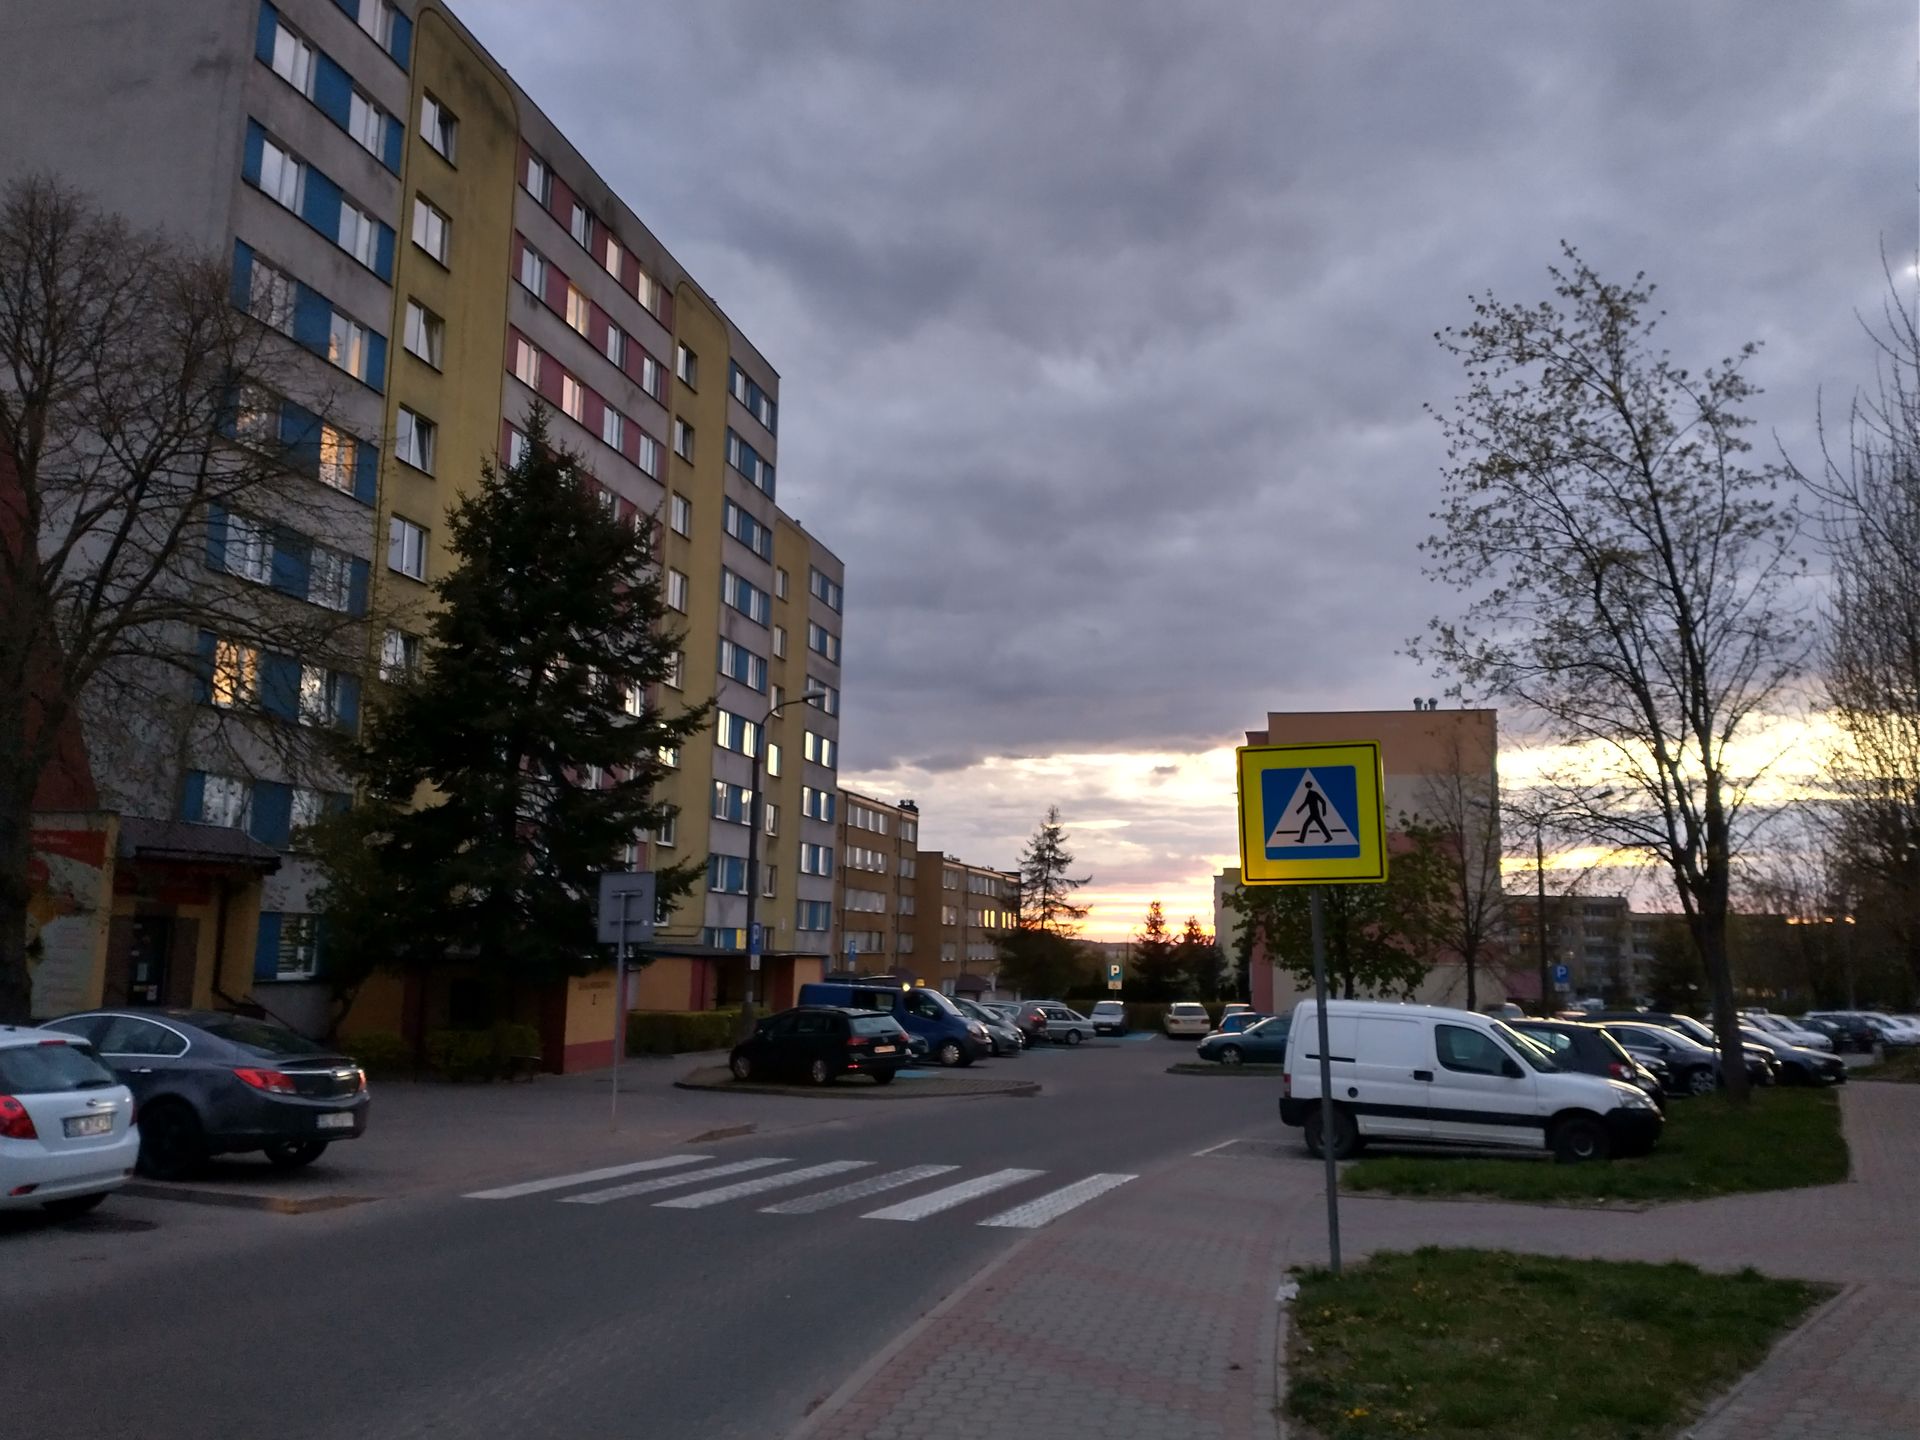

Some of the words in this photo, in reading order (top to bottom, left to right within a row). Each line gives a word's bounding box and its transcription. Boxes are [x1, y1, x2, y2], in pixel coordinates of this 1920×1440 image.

[753, 924, 760, 945] P
[1110, 964, 1120, 976] P
[1557, 965, 1567, 978] P
